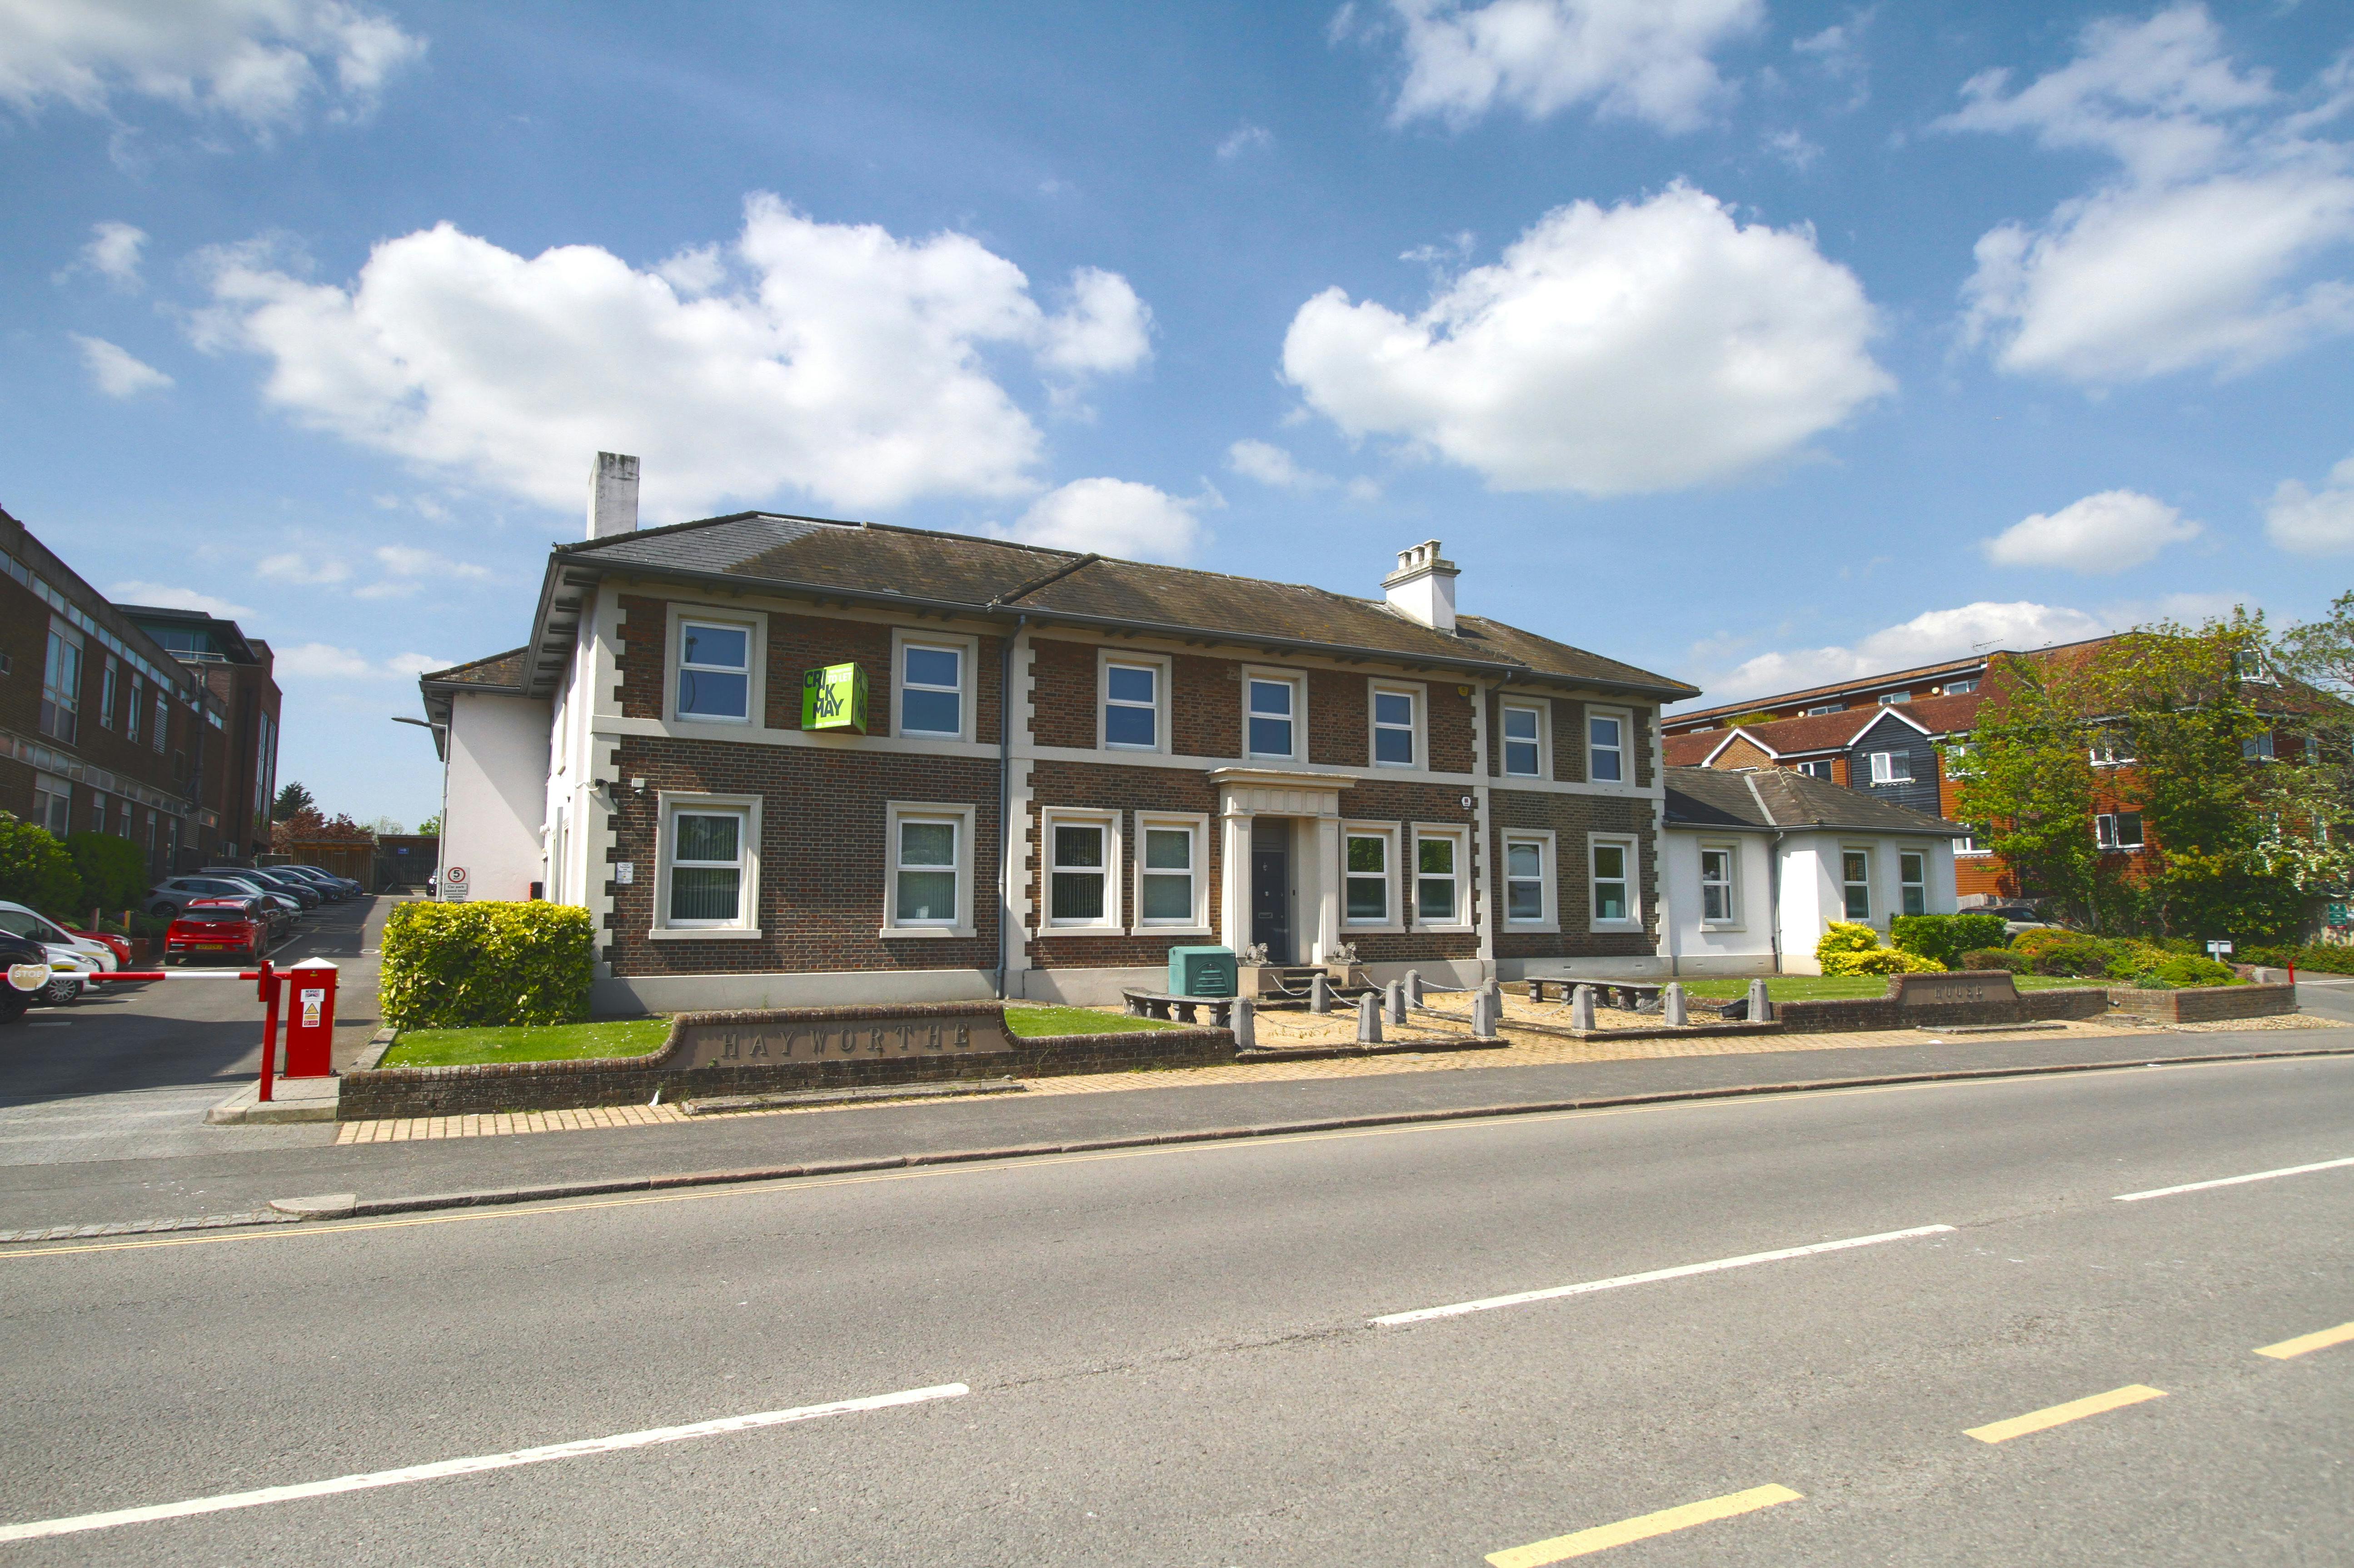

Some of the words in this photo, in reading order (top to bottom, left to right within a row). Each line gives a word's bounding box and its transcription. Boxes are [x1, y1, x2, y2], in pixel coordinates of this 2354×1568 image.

[828, 675, 837, 683] TO
[839, 672, 852, 682] LET
[813, 699, 843, 719] MAY
[453, 870, 460, 878] 5
[720, 1022, 970, 1057] HAYWORTHE
